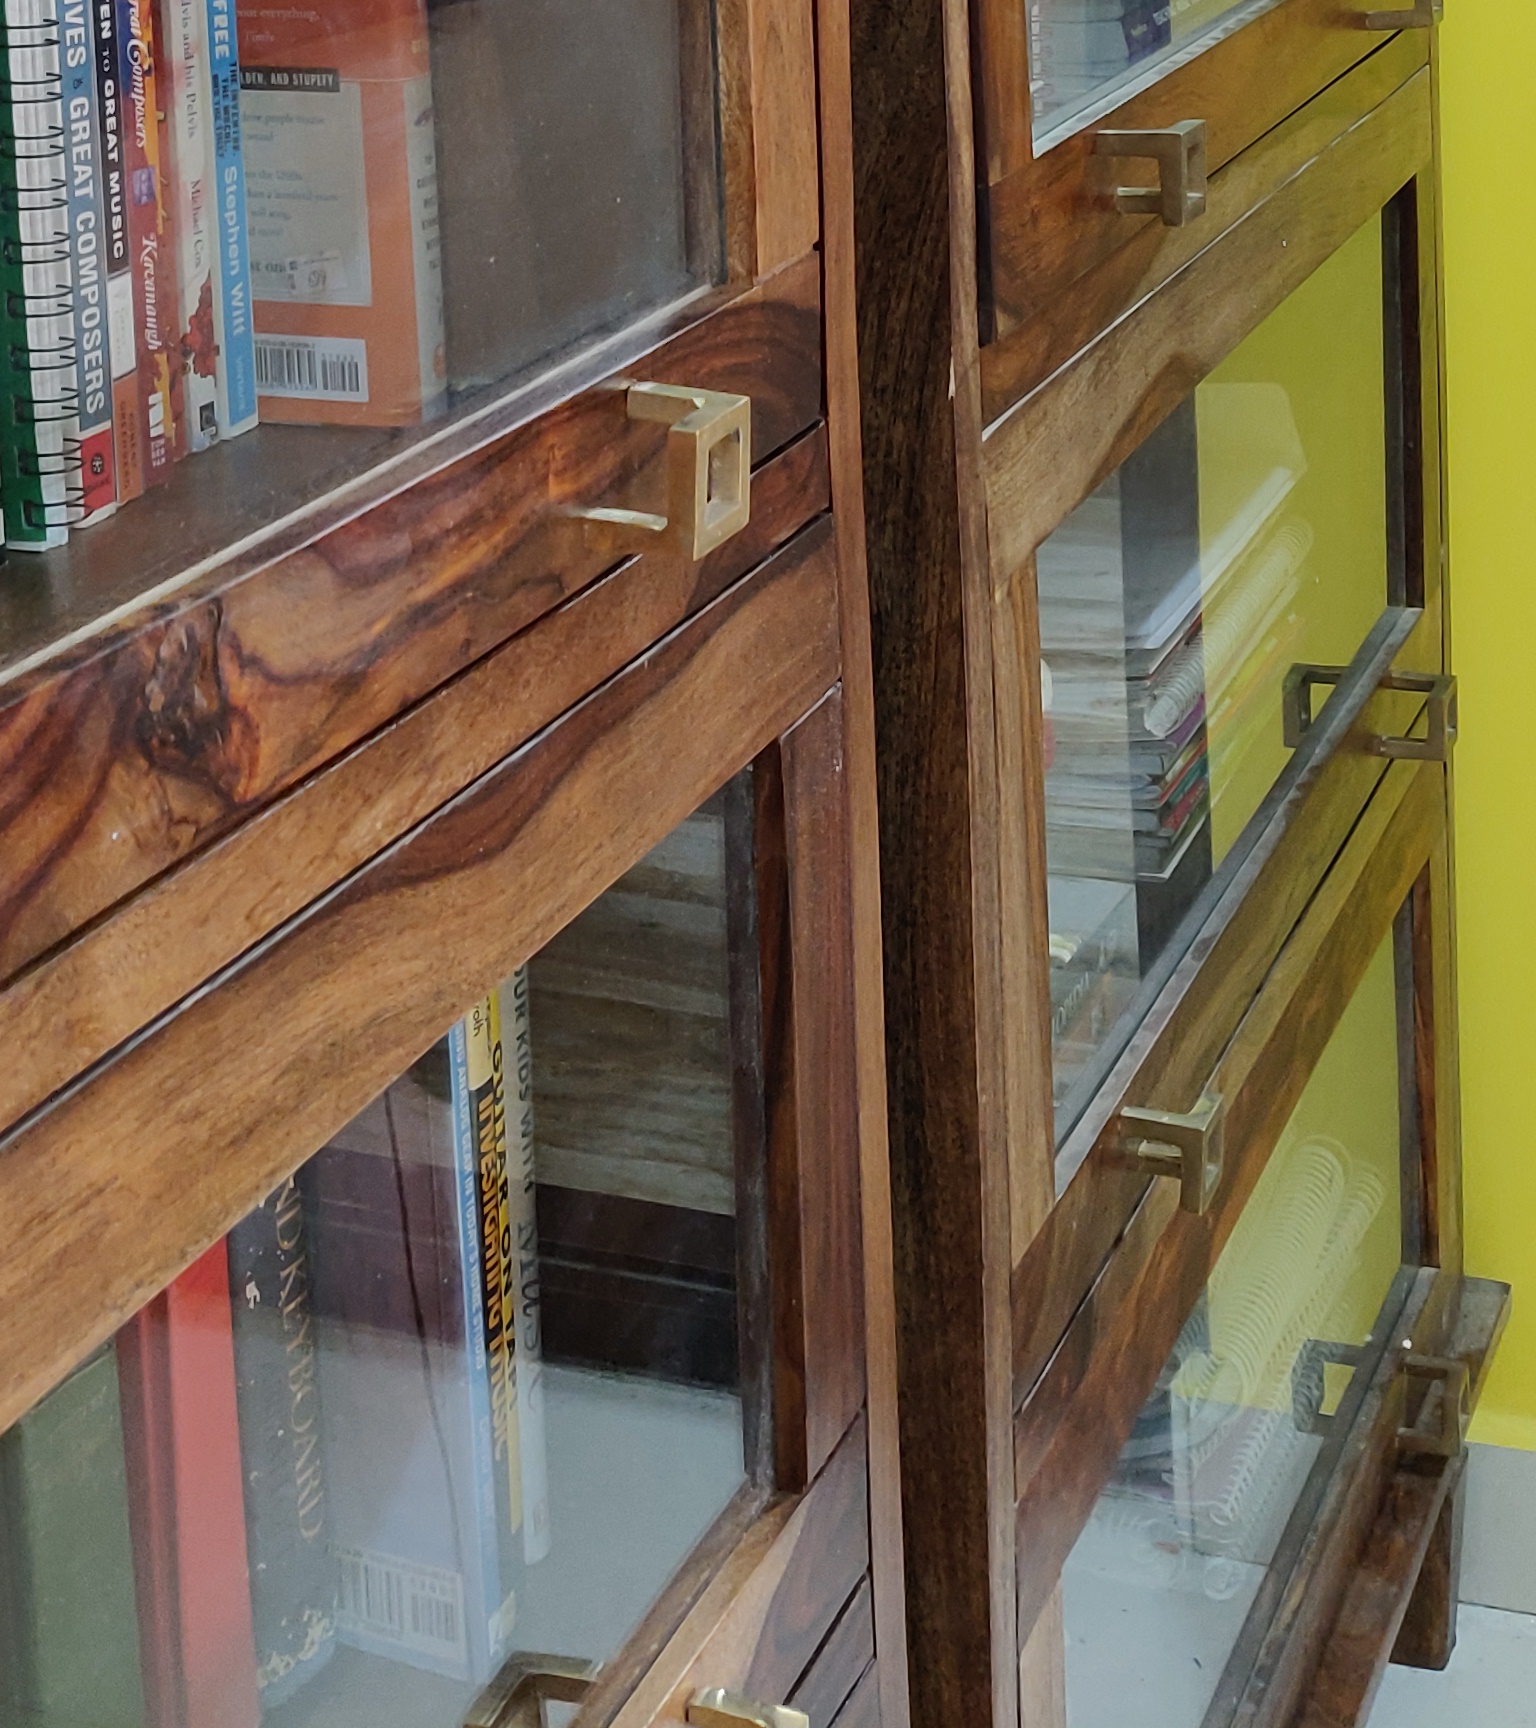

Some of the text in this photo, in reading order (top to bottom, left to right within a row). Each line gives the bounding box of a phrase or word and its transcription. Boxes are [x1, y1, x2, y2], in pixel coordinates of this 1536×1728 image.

[101, 47, 112, 73] TO
[182, 32, 194, 62] and
[183, 64, 195, 88] his
[270, 72, 290, 88] AND
[103, 79, 121, 164] GREAT
[126, 38, 154, 149] Composers
[185, 92, 198, 139] Pelvis
[68, 95, 95, 200] GREAT
[108, 170, 124, 260] MUSIC
[189, 178, 205, 270] Michael Cox
[223, 165, 249, 337] Stephen Witt
[75, 210, 106, 416] COMPOSERS
[137, 232, 163, 352] Kavanaugh
[516, 1032, 532, 1102] KIDS
[492, 1040, 514, 1297] GUITAR ON
[278, 1254, 325, 1542] KEYBOARD
